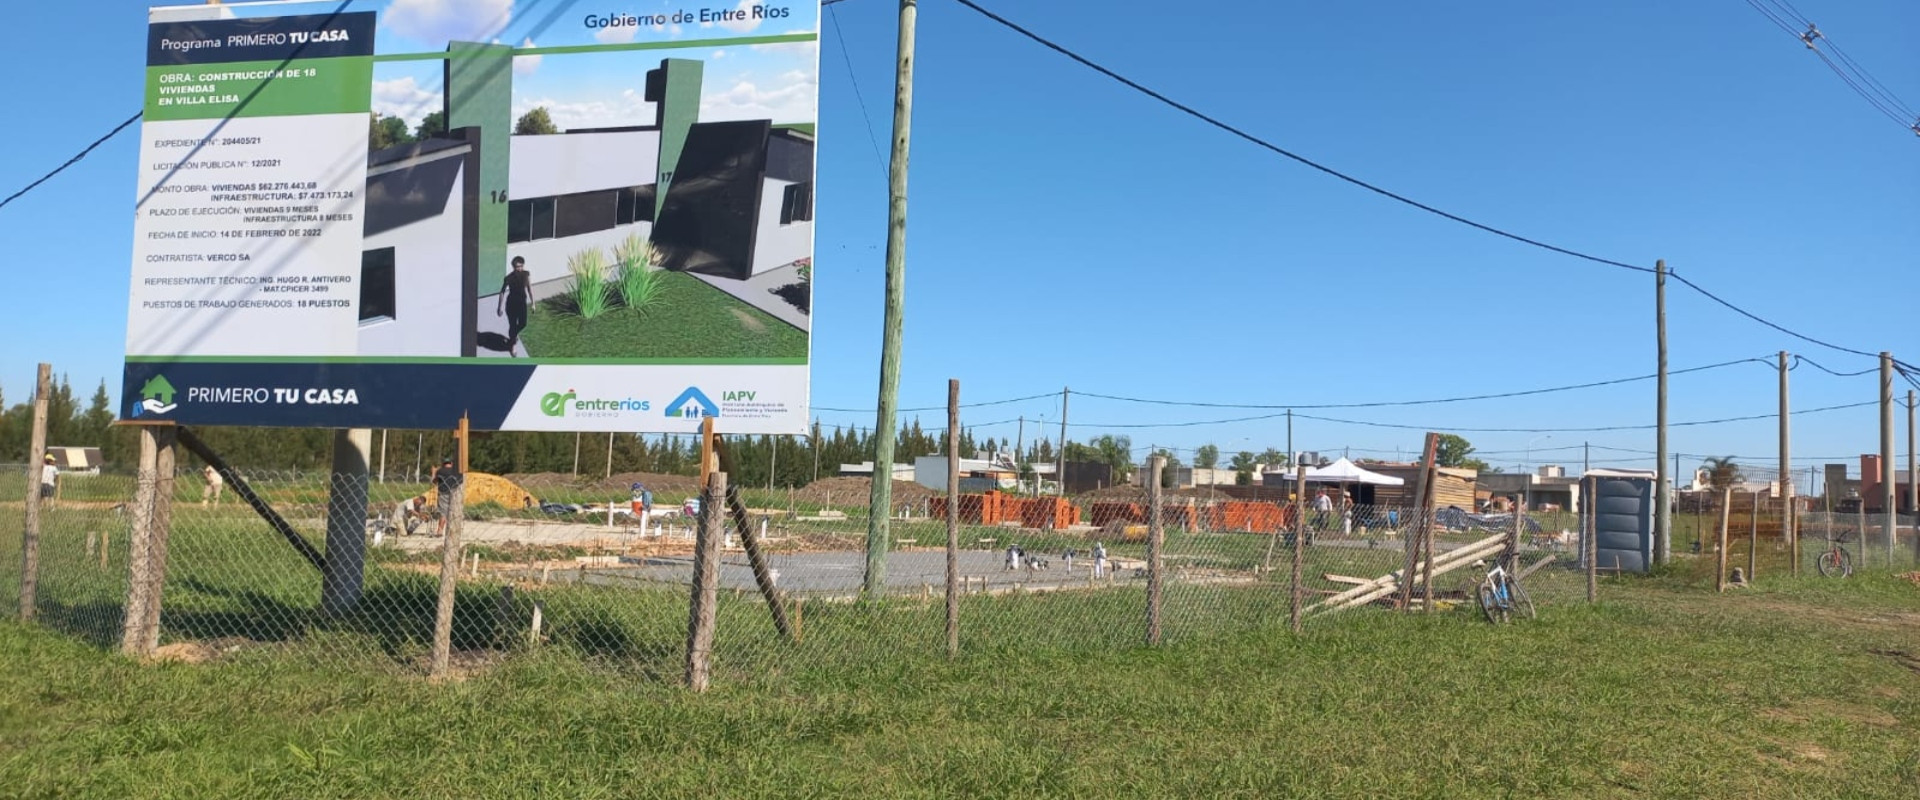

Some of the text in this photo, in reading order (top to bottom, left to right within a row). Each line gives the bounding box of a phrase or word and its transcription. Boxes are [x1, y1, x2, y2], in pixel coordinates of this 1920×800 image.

[584, 5, 790, 29] Gobierno de Entre Ríos
[161, 30, 349, 52] Programa PRIMERO TU CASA
[159, 68, 316, 83] OBRA: CONSTRUCCIÓN DE 18
[159, 85, 215, 94] VIVIENDAS
[158, 94, 239, 106] EN VILLA ELISA
[222, 137, 261, 145] 204405/21
[200, 160, 236, 169] PÚBLICA
[251, 159, 281, 167] 12/2021
[661, 172, 672, 182] 17
[211, 183, 256, 191] VIVIENDAS
[210, 192, 296, 202] INFRAESTRUCTURA:
[490, 190, 507, 204] 16
[149, 208, 176, 216] PLAZO
[178, 207, 190, 215] DE
[244, 206, 284, 214] VIVIENDAS
[292, 205, 319, 213] MESES
[243, 214, 318, 223] INFRAESTRUCTURA
[326, 213, 353, 221] MESES
[148, 231, 176, 239] FECHA
[177, 230, 189, 238] DE
[220, 230, 229, 238] 14
[231, 230, 243, 238] DE
[245, 229, 286, 237] FEBRERO
[288, 228, 300, 237] DE
[302, 228, 322, 237] 2022
[206, 253, 237, 261] VERCO
[238, 253, 251, 261] SA
[144, 276, 217, 286] REPRESENTANTE
[276, 276, 300, 284] HUGO
[311, 275, 352, 283] ANTIVERO
[143, 300, 182, 309] PUESTOS
[184, 300, 197, 308] DE
[199, 299, 237, 308] TRABAJO
[297, 299, 307, 307] 18
[308, 299, 350, 307] PUESTOS
[188, 387, 359, 404] PRIMERO TU CASA
[722, 390, 757, 402] IAPV
